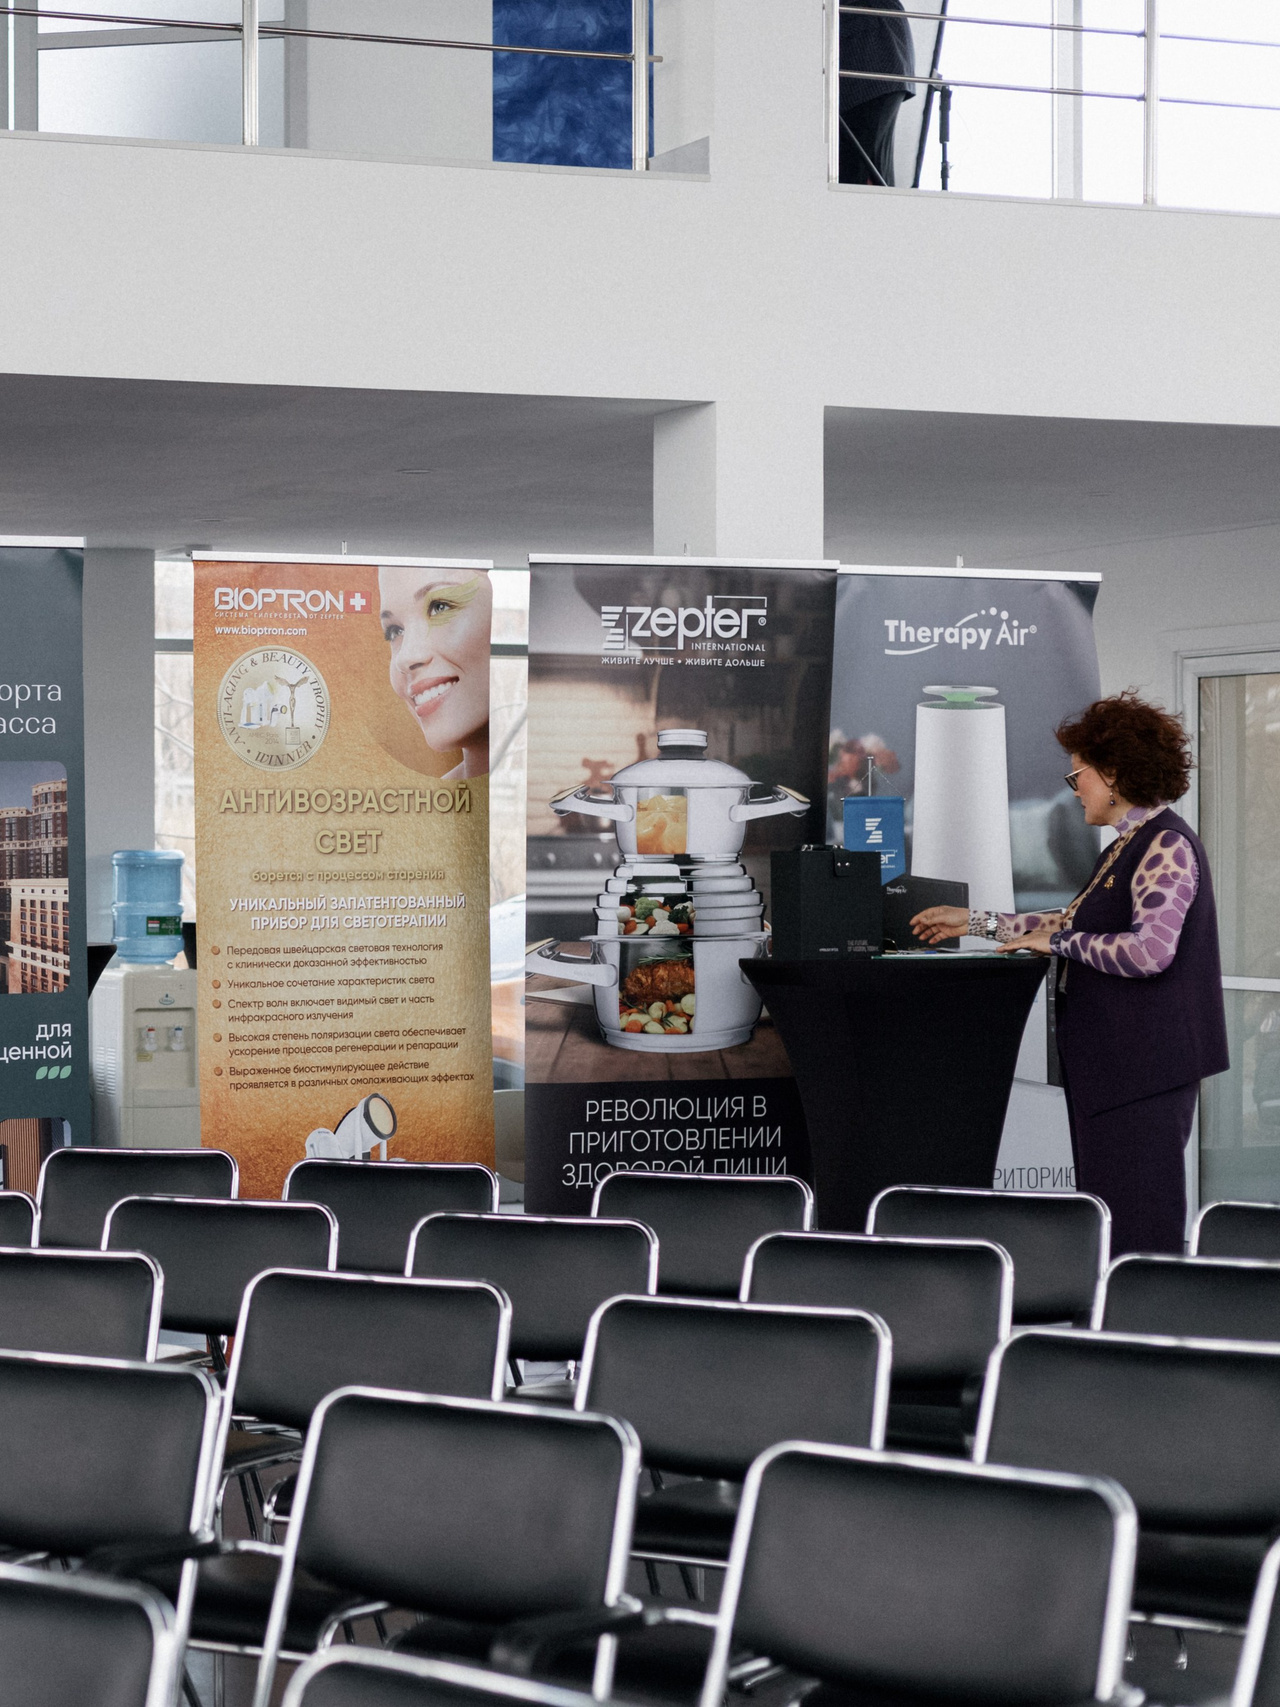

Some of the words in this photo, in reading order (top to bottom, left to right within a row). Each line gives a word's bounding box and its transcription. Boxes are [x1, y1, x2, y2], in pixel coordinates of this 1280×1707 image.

[214, 587, 344, 618] BIOPTRON
[215, 625, 308, 637] www.bioptron.com
[884, 619, 992, 650] Therapy
[691, 642, 766, 652] INTERNATIONAL
[601, 656, 640, 665] ЖИВИТЕ
[643, 657, 674, 666] ЛУЧШЕ
[685, 658, 722, 666] ЖИВИТЕ
[725, 659, 765, 667] ДОЛЬШЕ
[262, 651, 311, 675] BEAUTY
[310, 677, 326, 732] TROPHY
[255, 740, 312, 766] WINNER
[219, 784, 471, 814] АНТИВОЗРАСТНОЙ
[315, 829, 382, 855] СВЕТ
[252, 870, 304, 883] борется
[306, 872, 314, 881] с
[317, 871, 385, 883] процессом
[386, 870, 445, 882] старения
[229, 895, 327, 912] УНИКАЛЬНЫЙ
[330, 893, 466, 910] ЗАПАТЕНТОВАННЫЙ
[251, 916, 307, 931] ПРИБОР
[310, 916, 340, 932] ДЛЯ
[342, 915, 448, 929] СВЕТОТЕРАПИИ
[227, 945, 281, 956] Передовая
[283, 944, 347, 956] швейцарская
[348, 943, 390, 953] световая
[392, 942, 444, 952] технология
[235, 960, 291, 969] клинически
[293, 957, 349, 969] доказанной
[350, 957, 427, 968] эффективностью
[227, 979, 284, 989] Уникальное
[286, 978, 336, 988] сочетание
[337, 977, 407, 988] характеристик
[409, 976, 435, 984] света
[227, 999, 264, 1010] Спектр
[266, 999, 288, 1008] волн
[290, 997, 335, 1007] включает
[337, 995, 377, 1007] видимый
[378, 996, 399, 1004] свет
[400, 996, 407, 1004] и
[409, 995, 435, 1004] часть
[228, 1012, 304, 1024] инфракрасного
[306, 1011, 354, 1022] излучения
[35, 1023, 72, 1041] для
[228, 1032, 270, 1042] Высокая
[272, 1031, 309, 1040] степень
[311, 1029, 372, 1041] поляризации
[374, 1028, 400, 1038] света
[401, 1026, 467, 1037] обеспечивает
[229, 1047, 281, 1058] ускорение
[282, 1045, 333, 1056] процессов
[335, 1043, 396, 1054] регенерации
[398, 1043, 405, 1051] и
[406, 1040, 459, 1052] репарации
[229, 1066, 291, 1077] Выраженное
[293, 1062, 385, 1074] биостимулирующее
[387, 1060, 430, 1071] действие
[229, 1079, 289, 1091] проявляется
[291, 1079, 297, 1087] в
[298, 1077, 348, 1088] различных
[350, 1074, 429, 1085] омолаживающих
[431, 1072, 475, 1083] эффектах
[586, 1096, 744, 1122] РЕВОЛЮЦИЯ
[753, 1095, 767, 1117] В
[570, 1126, 781, 1154] ПРИГОТОВЛЕНИИ
[993, 1166, 1076, 1189] РИТОРИЮ
